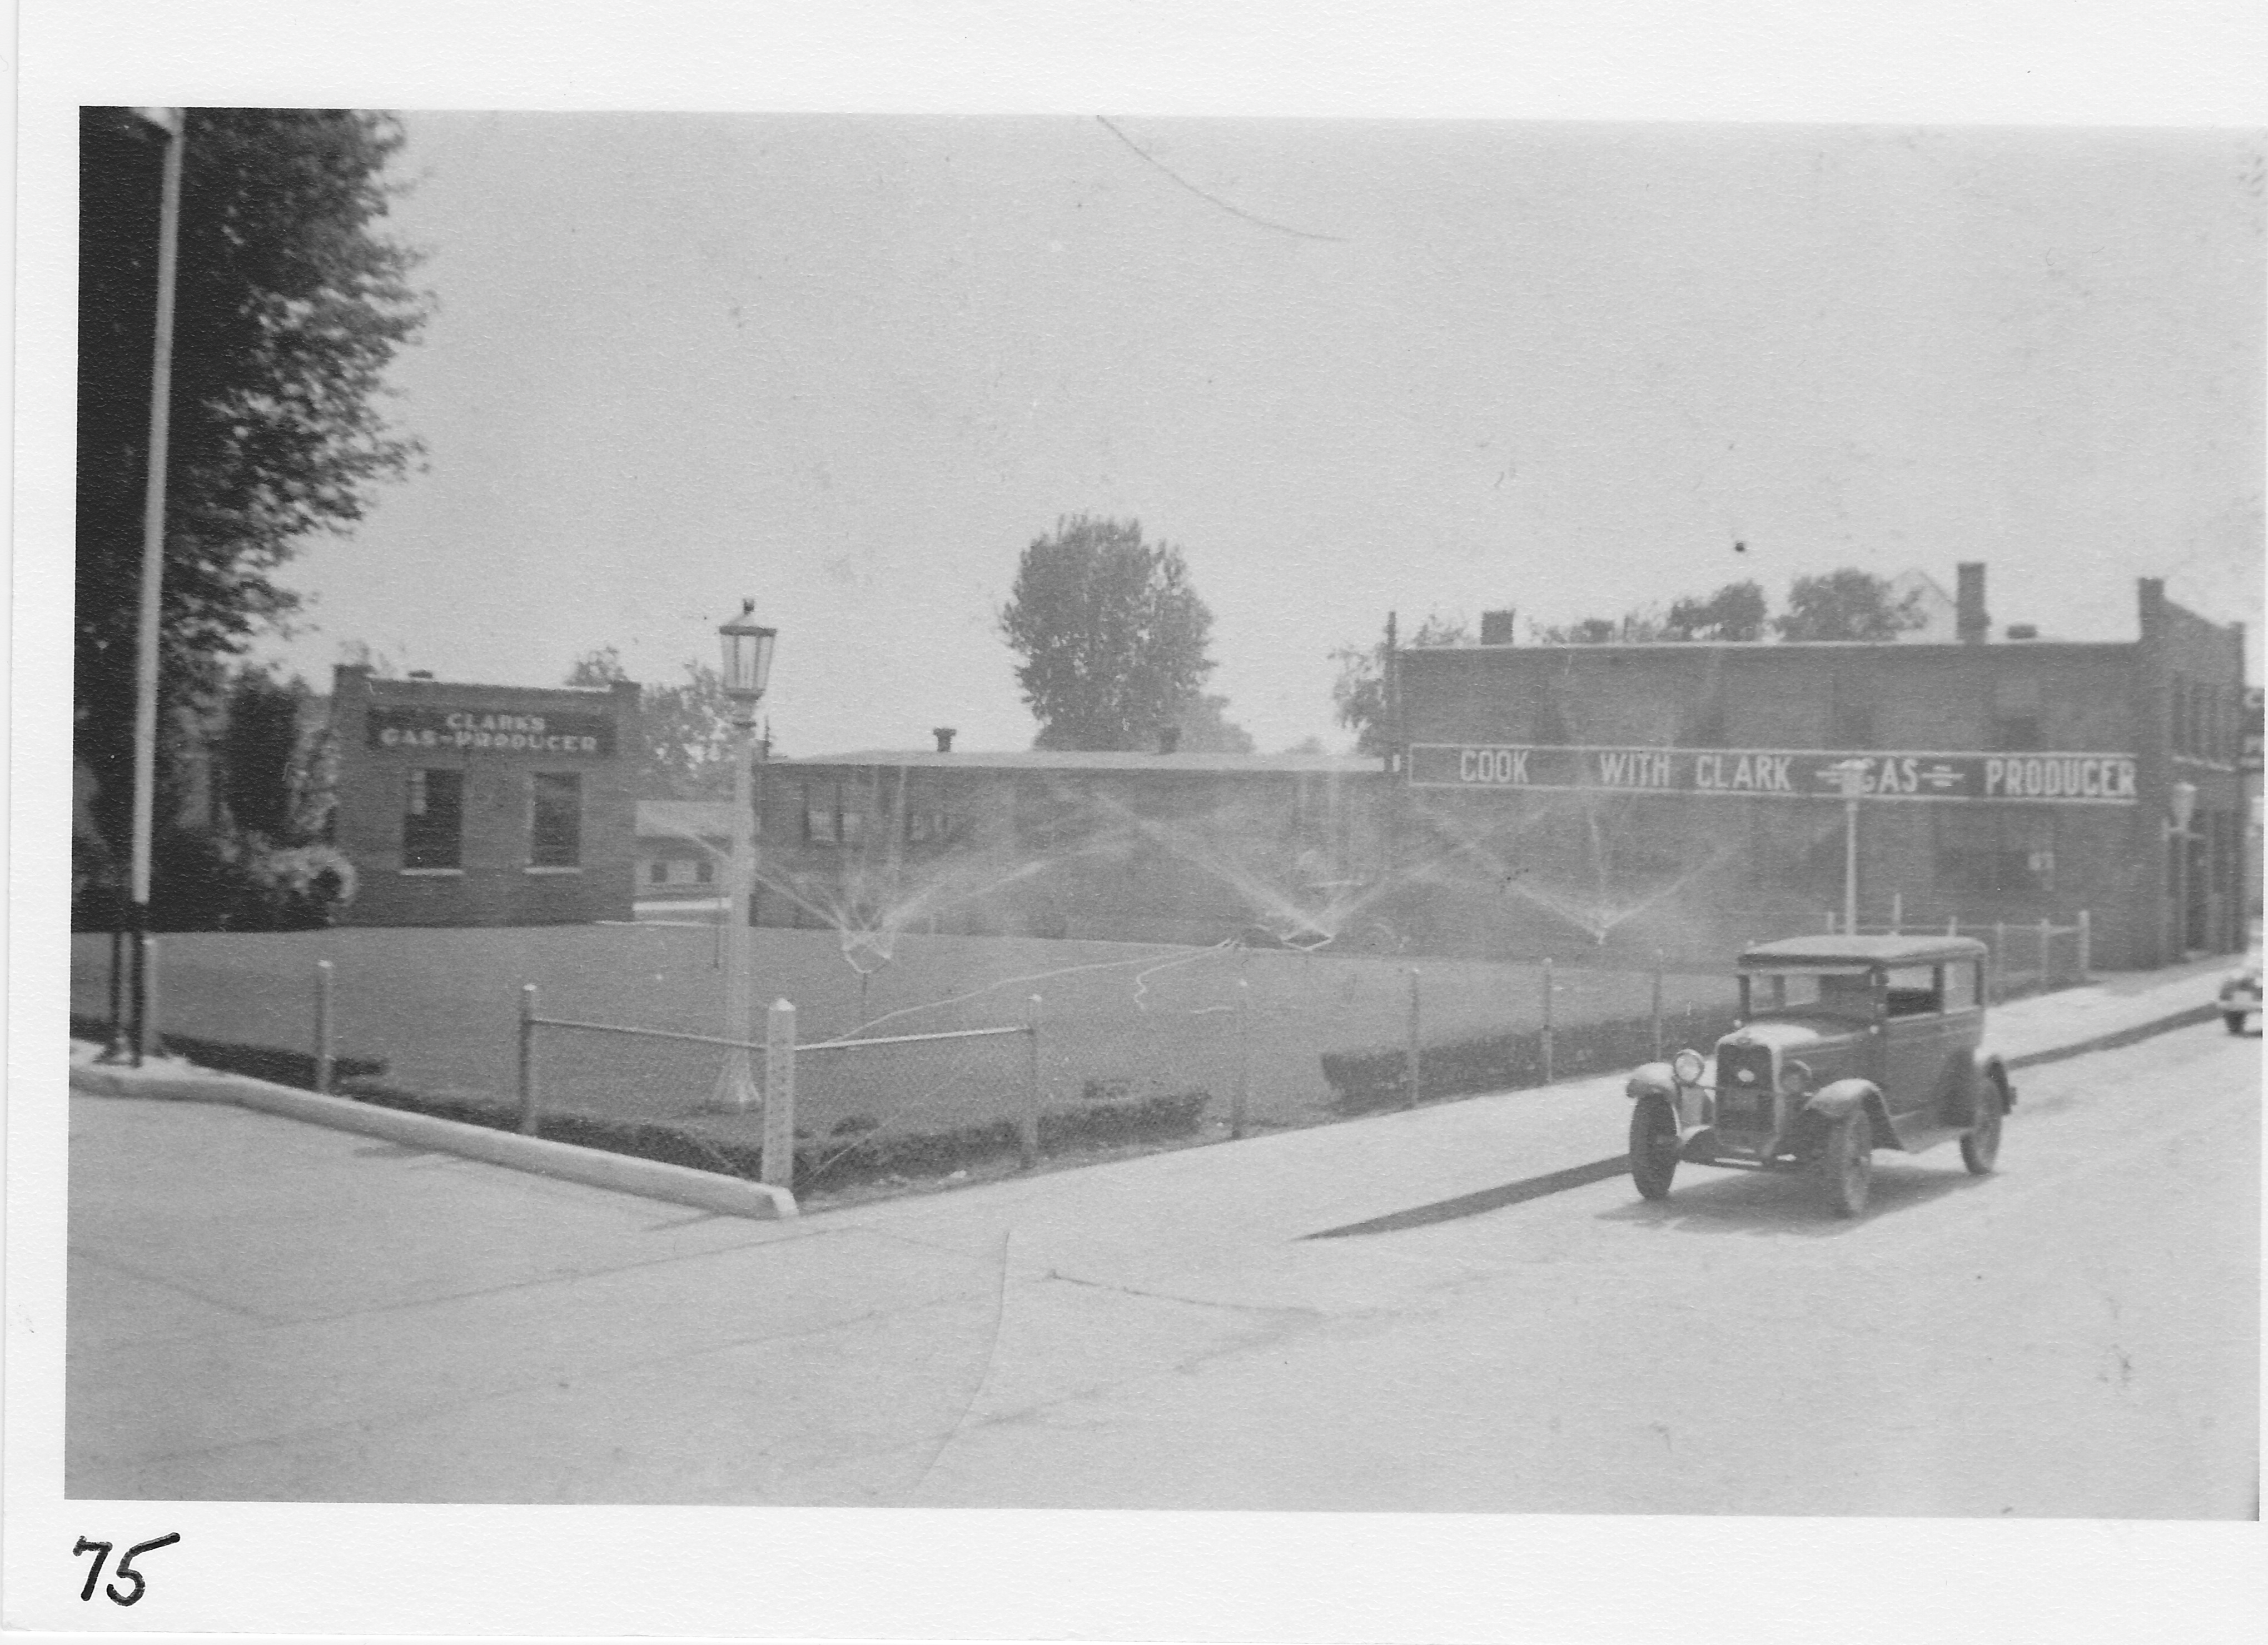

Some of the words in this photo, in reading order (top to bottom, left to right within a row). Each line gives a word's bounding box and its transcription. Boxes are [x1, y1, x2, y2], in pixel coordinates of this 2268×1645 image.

[1460, 749, 1529, 783] COOK
[1600, 751, 1669, 787] WITH
[1695, 755, 1792, 790] CLARK
[1986, 759, 2136, 796] PRODUCER
[73, 1532, 181, 1607] 75
